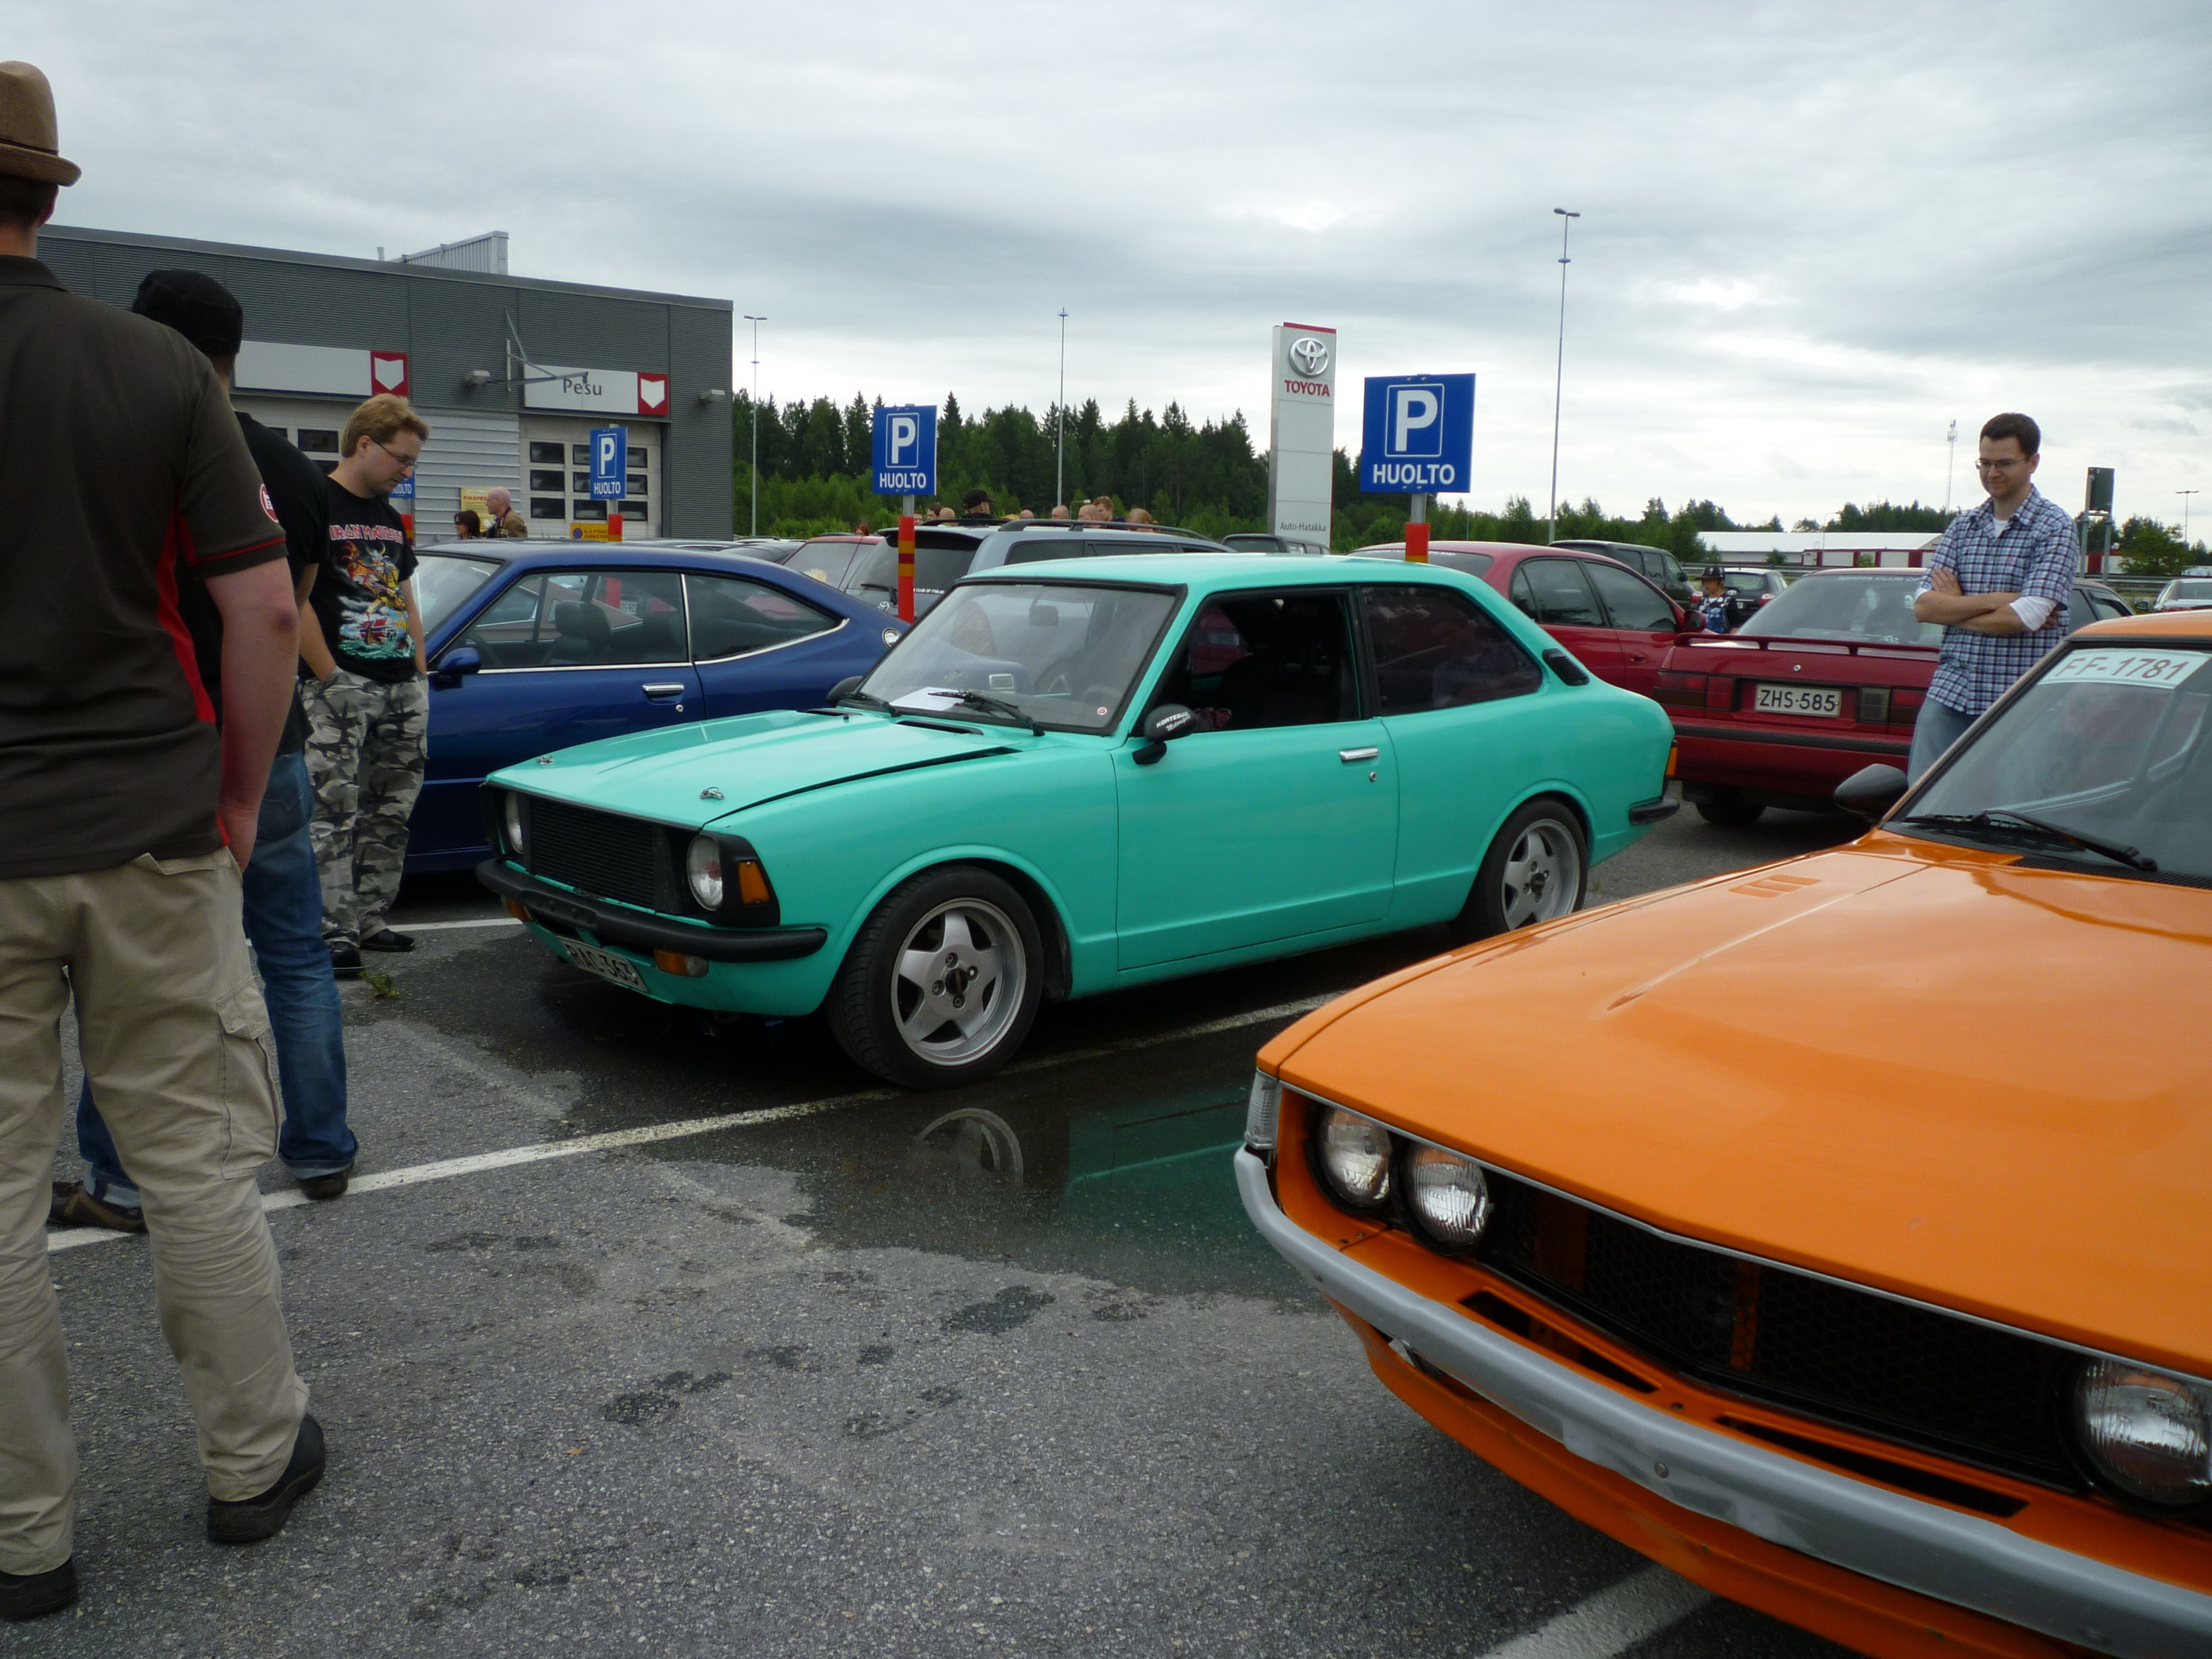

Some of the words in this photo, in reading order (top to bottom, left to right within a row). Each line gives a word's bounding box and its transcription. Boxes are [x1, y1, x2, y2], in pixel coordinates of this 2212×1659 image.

[563, 378, 602, 395] Pesu
[1284, 379, 1330, 397] TOYOTA
[1396, 389, 1438, 451] P
[891, 417, 916, 464] P
[601, 437, 615, 475] P
[880, 473, 927, 488] HUOLTO
[1373, 464, 1455, 484] HUOLTO
[594, 481, 621, 495] HUOLTO
[329, 524, 362, 540] IRON
[1280, 522, 1326, 532] Auto-Hatakka
[2054, 656, 2189, 681] FF-1781
[1759, 689, 1836, 712] ZHS-585
[564, 943, 639, 986] RAC-363
